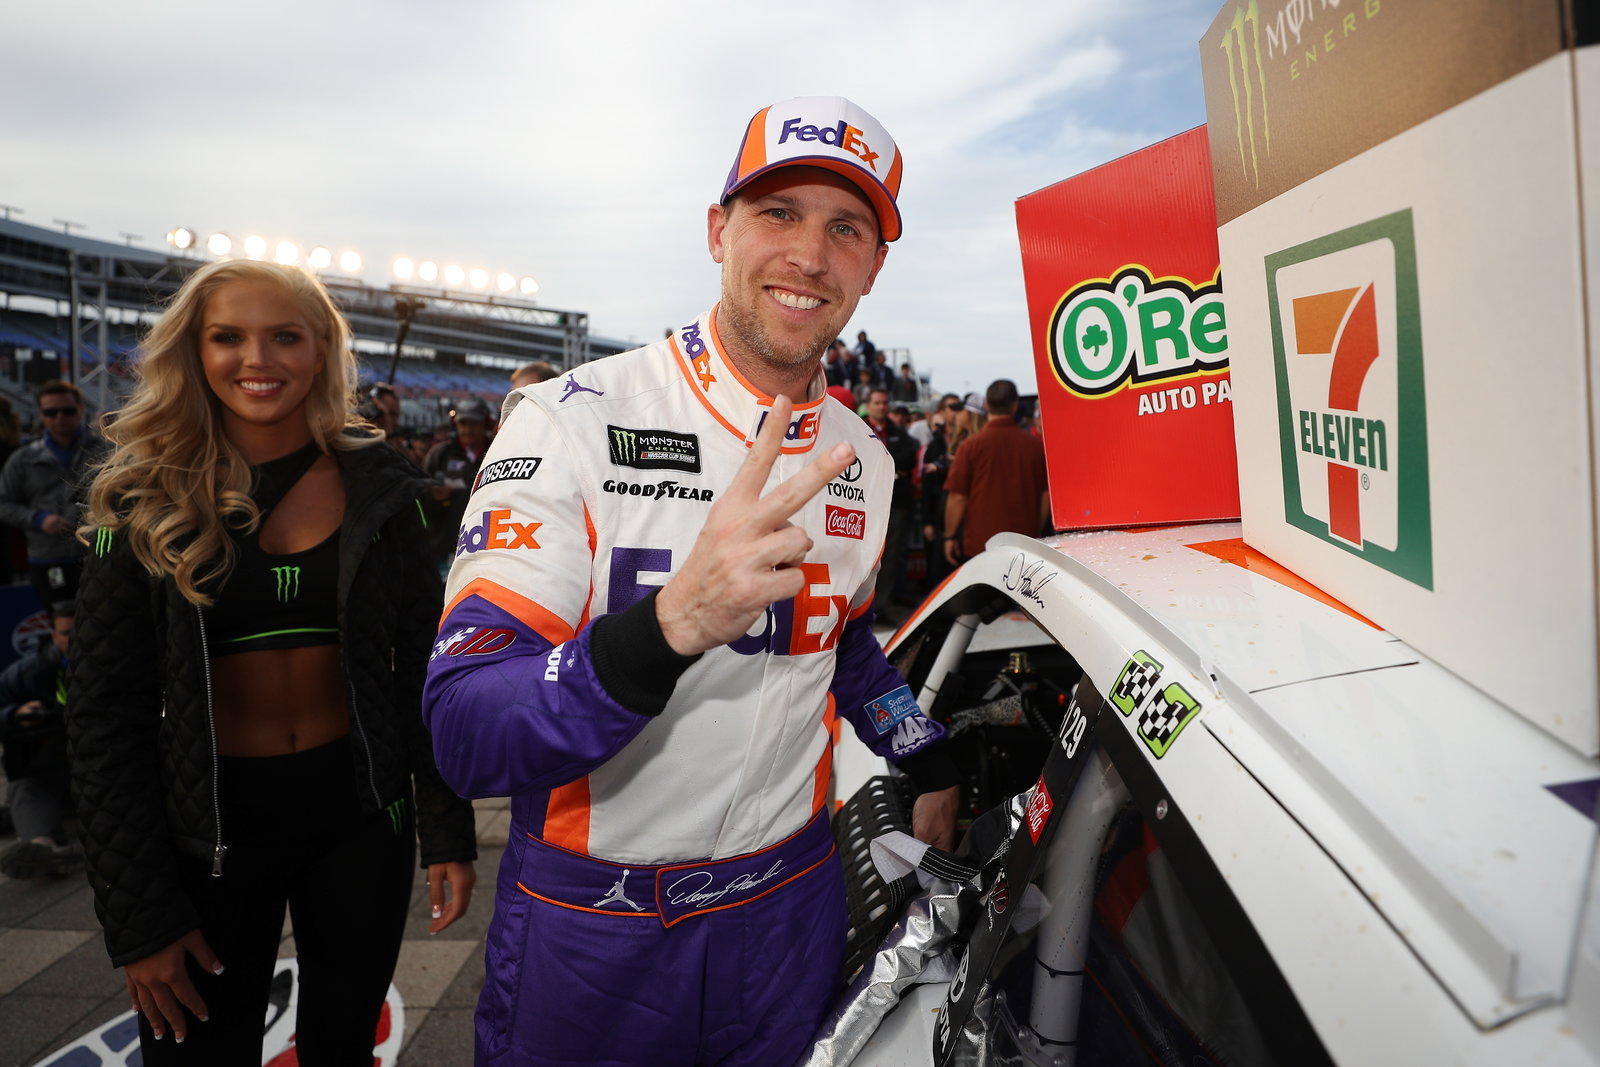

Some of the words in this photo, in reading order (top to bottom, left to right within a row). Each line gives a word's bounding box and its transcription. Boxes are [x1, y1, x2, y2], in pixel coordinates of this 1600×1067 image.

[778, 117, 880, 173] FedEx
[1138, 386, 1197, 416] AUTO
[639, 436, 695, 450] MONSTER
[478, 459, 536, 488] NASCAR
[603, 479, 714, 502] GOODYEAR
[827, 482, 866, 503] TOYOTA
